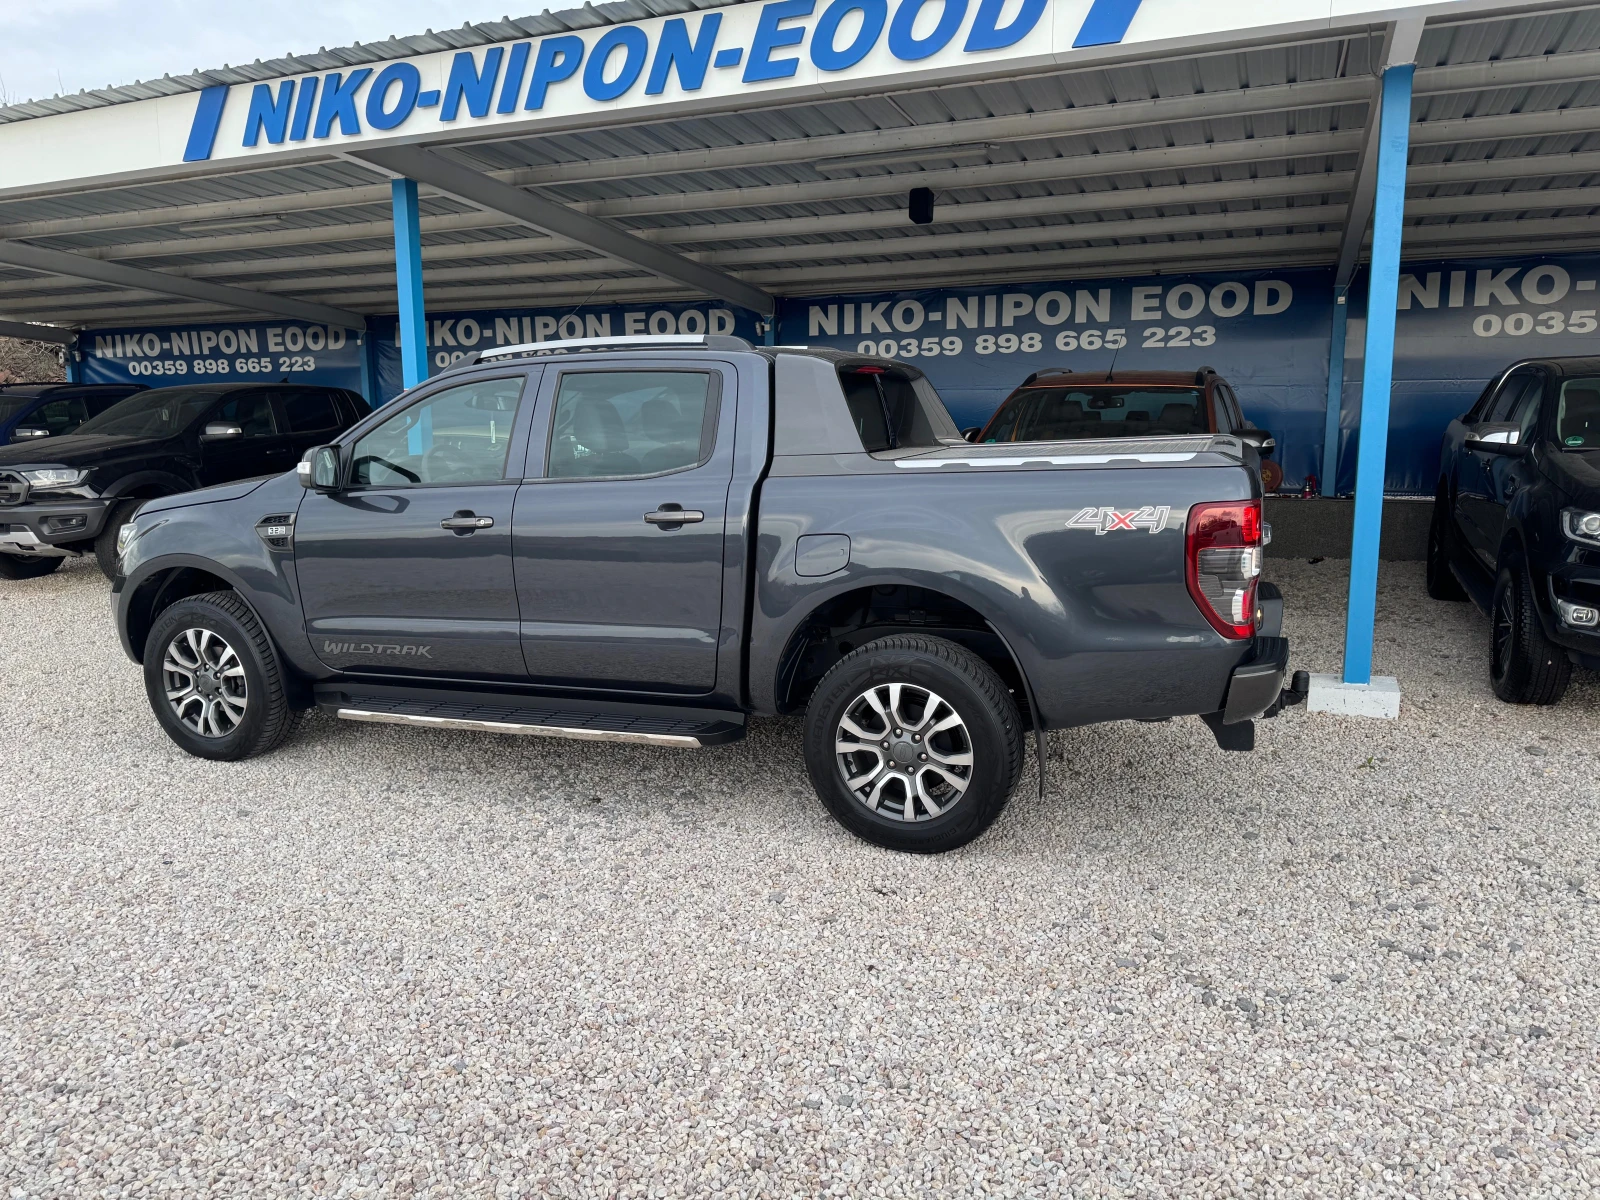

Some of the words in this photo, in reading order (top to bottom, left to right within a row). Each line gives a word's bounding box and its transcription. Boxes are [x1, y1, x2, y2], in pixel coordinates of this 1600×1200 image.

[242, 0, 1054, 147] NIKO-NIPON-EOOD
[809, 288, 1111, 336] NIKO-NIPON
[1130, 280, 1293, 322] EOOD
[1473, 310, 1598, 337] 0035
[95, 329, 259, 358] NIKO-NIPON
[267, 326, 346, 353] EOOD
[395, 313, 611, 348] IKO-NIPON
[624, 309, 735, 336] EOOD
[857, 336, 963, 357] 00359
[974, 332, 1043, 354] 898
[1055, 328, 1127, 350] 665
[1141, 325, 1217, 348] 223
[128, 360, 188, 376] 00359
[193, 359, 230, 374] 898
[235, 357, 273, 373] 665
[279, 356, 316, 372] 223
[324, 640, 433, 659] WILDTRAK
